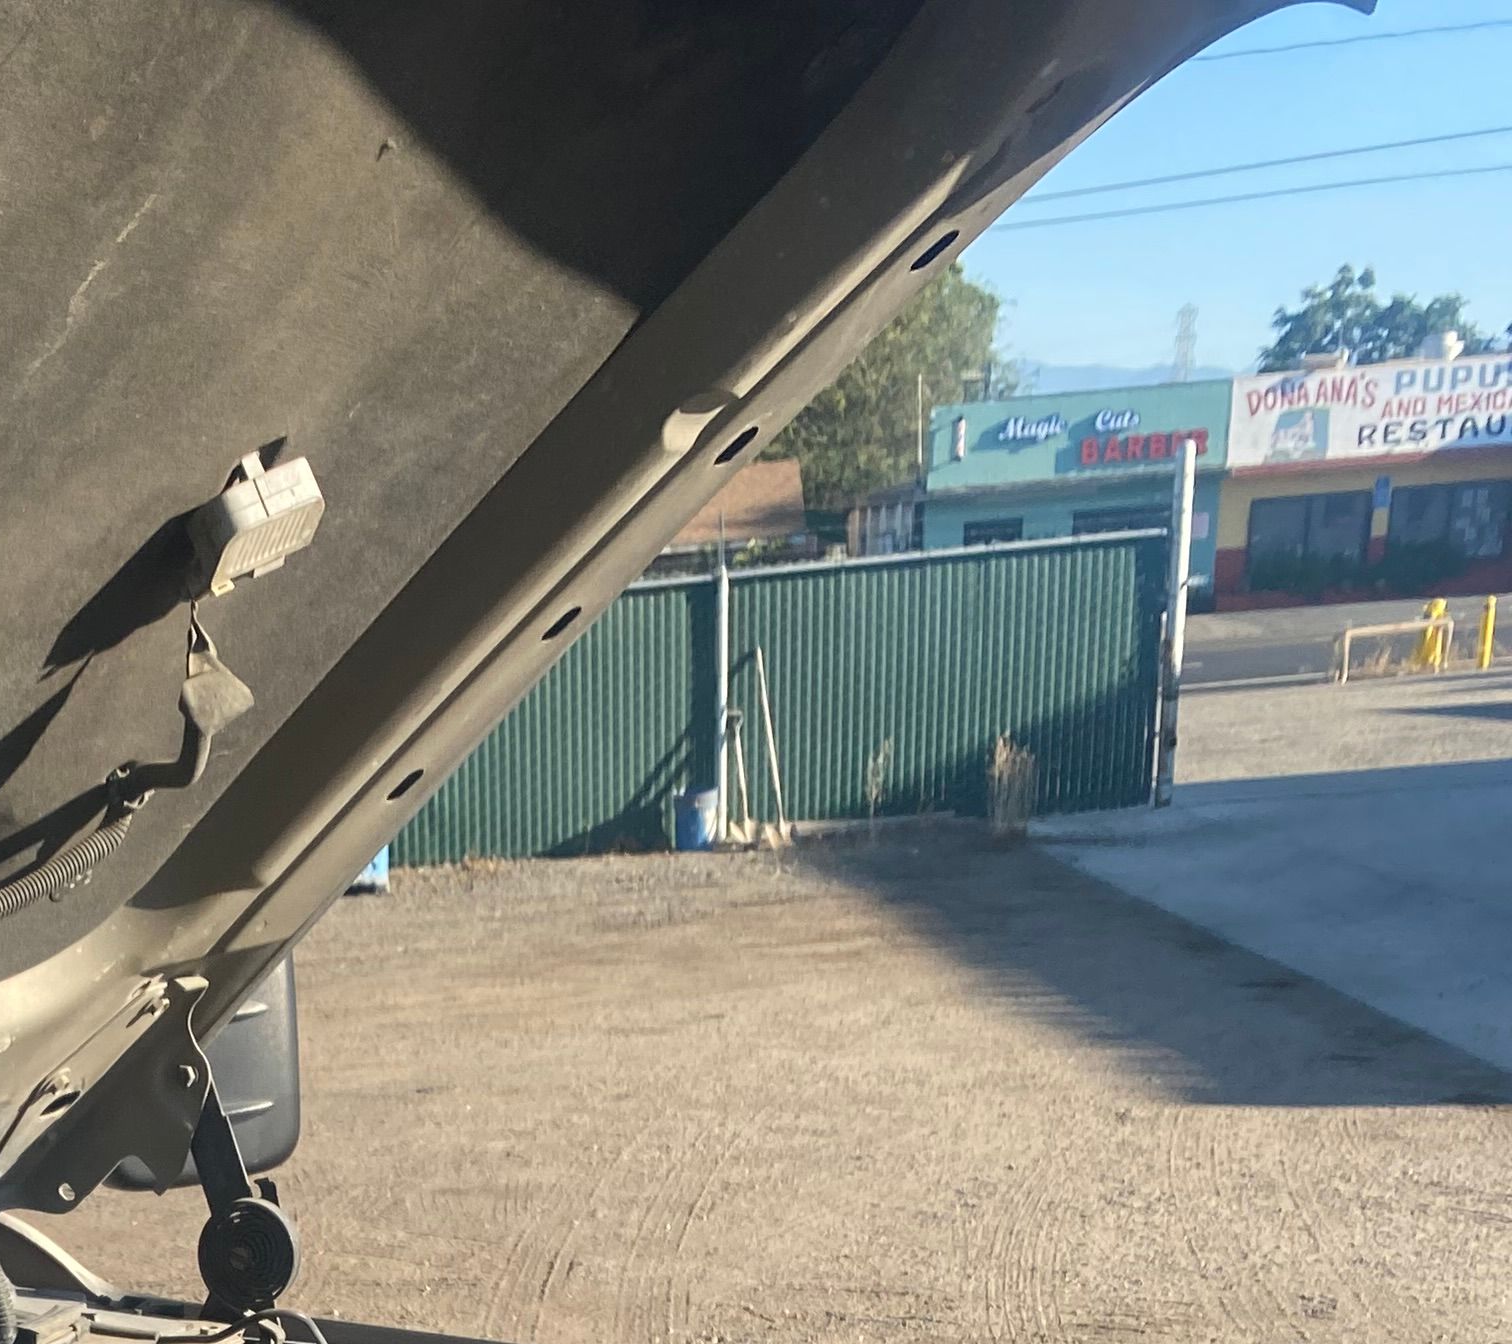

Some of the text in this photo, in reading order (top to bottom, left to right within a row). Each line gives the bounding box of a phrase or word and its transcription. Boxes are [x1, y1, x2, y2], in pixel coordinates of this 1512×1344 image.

[1315, 371, 1379, 409] ANA'S
[1394, 363, 1512, 395] PUPU
[998, 408, 1140, 441] Magic Cuts
[1381, 397, 1425, 419] AND
[1357, 415, 1512, 448] RESTAU
